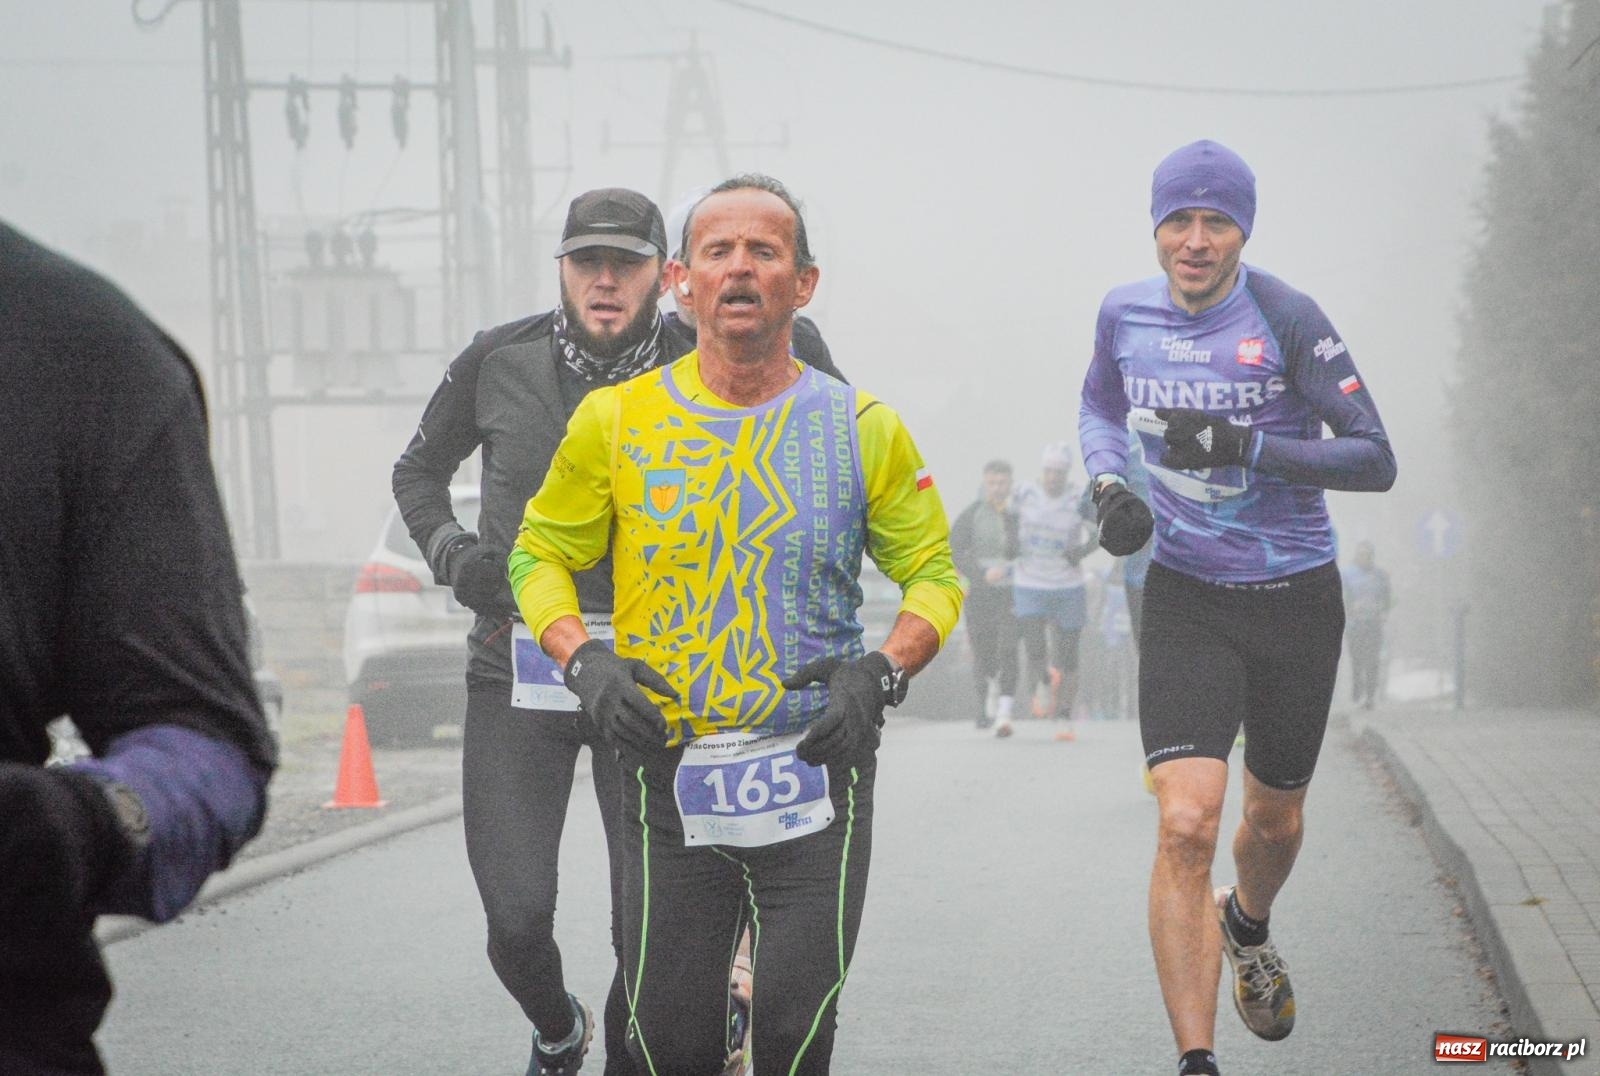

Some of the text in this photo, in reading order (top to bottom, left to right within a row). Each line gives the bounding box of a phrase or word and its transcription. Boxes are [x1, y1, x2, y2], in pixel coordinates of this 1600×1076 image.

[1122, 374, 1286, 410] UNNERS
[831, 390, 852, 512] JEJKOWICE
[726, 740, 736, 749] po
[703, 755, 800, 813] 165
